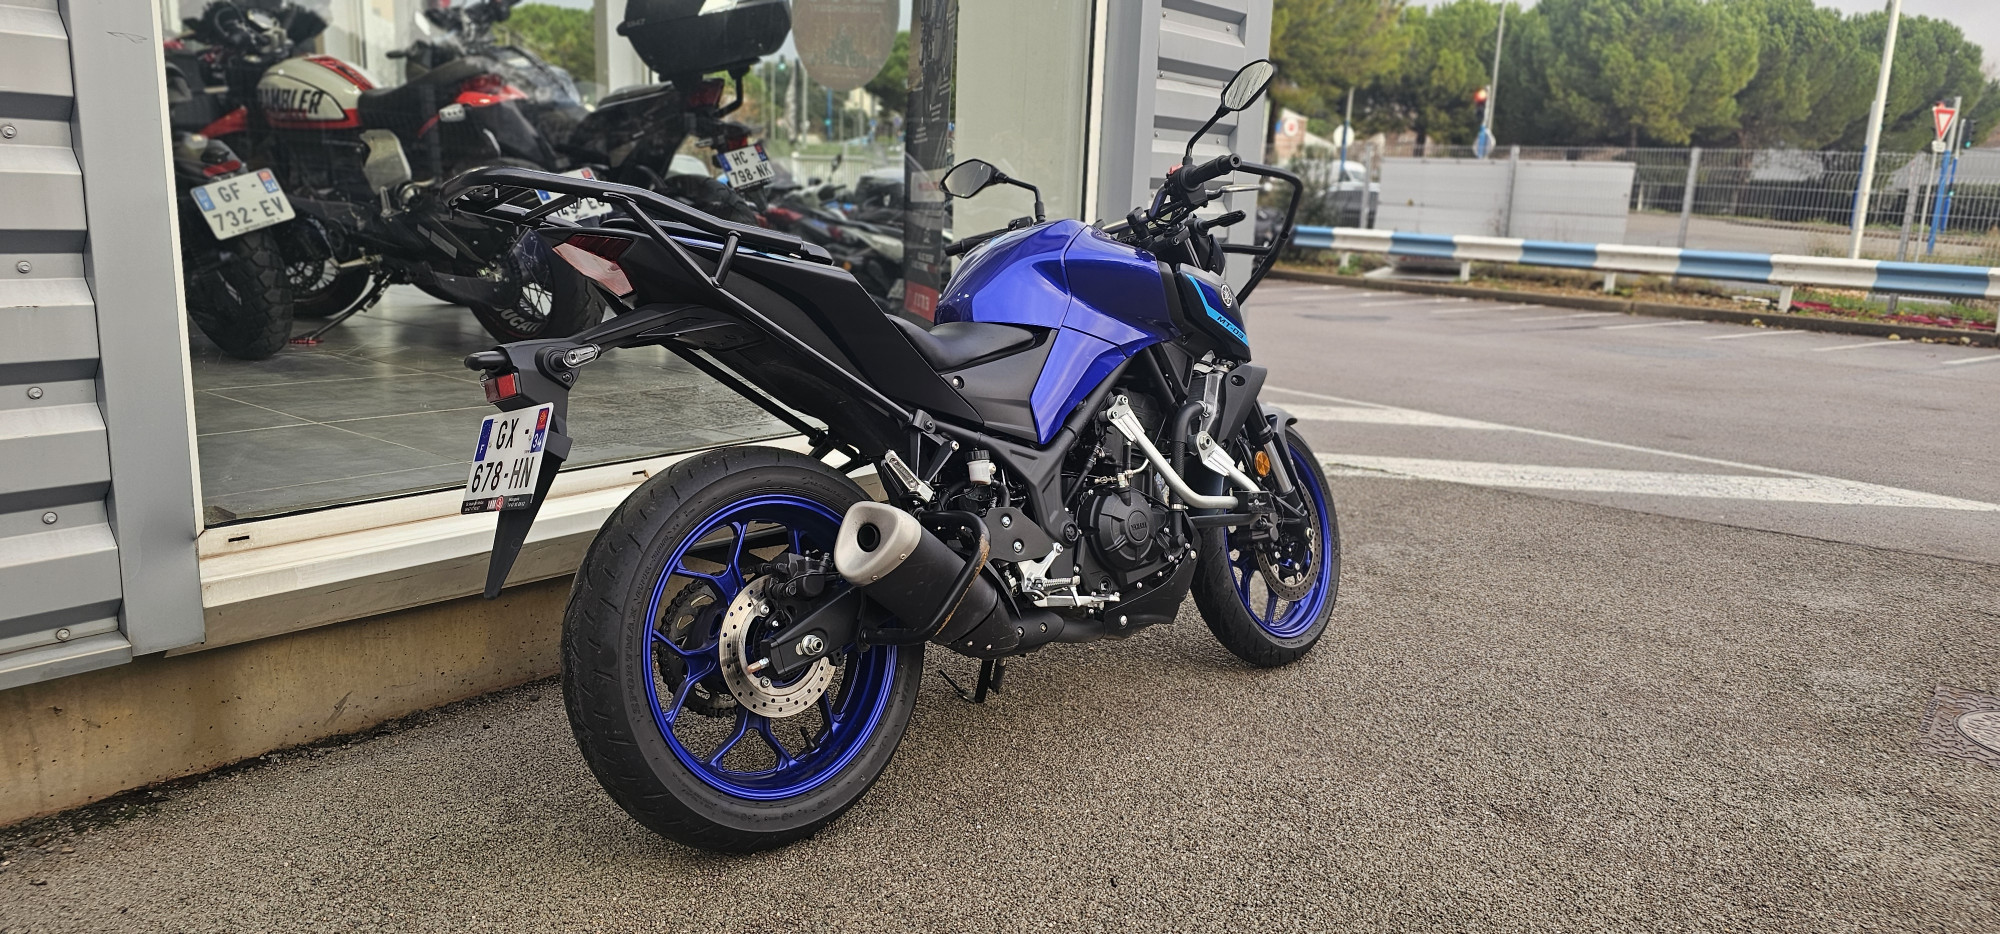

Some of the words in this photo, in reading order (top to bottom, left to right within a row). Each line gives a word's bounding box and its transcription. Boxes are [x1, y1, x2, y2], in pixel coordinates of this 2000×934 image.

[731, 150, 749, 167] HC
[730, 162, 772, 185] 798-NK
[217, 182, 240, 203] GF
[212, 196, 285, 232] 732-EV
[1216, 315, 1245, 340] MT-03
[496, 418, 519, 450] GX
[532, 433, 544, 448] 34
[471, 457, 535, 493] 678-HN
